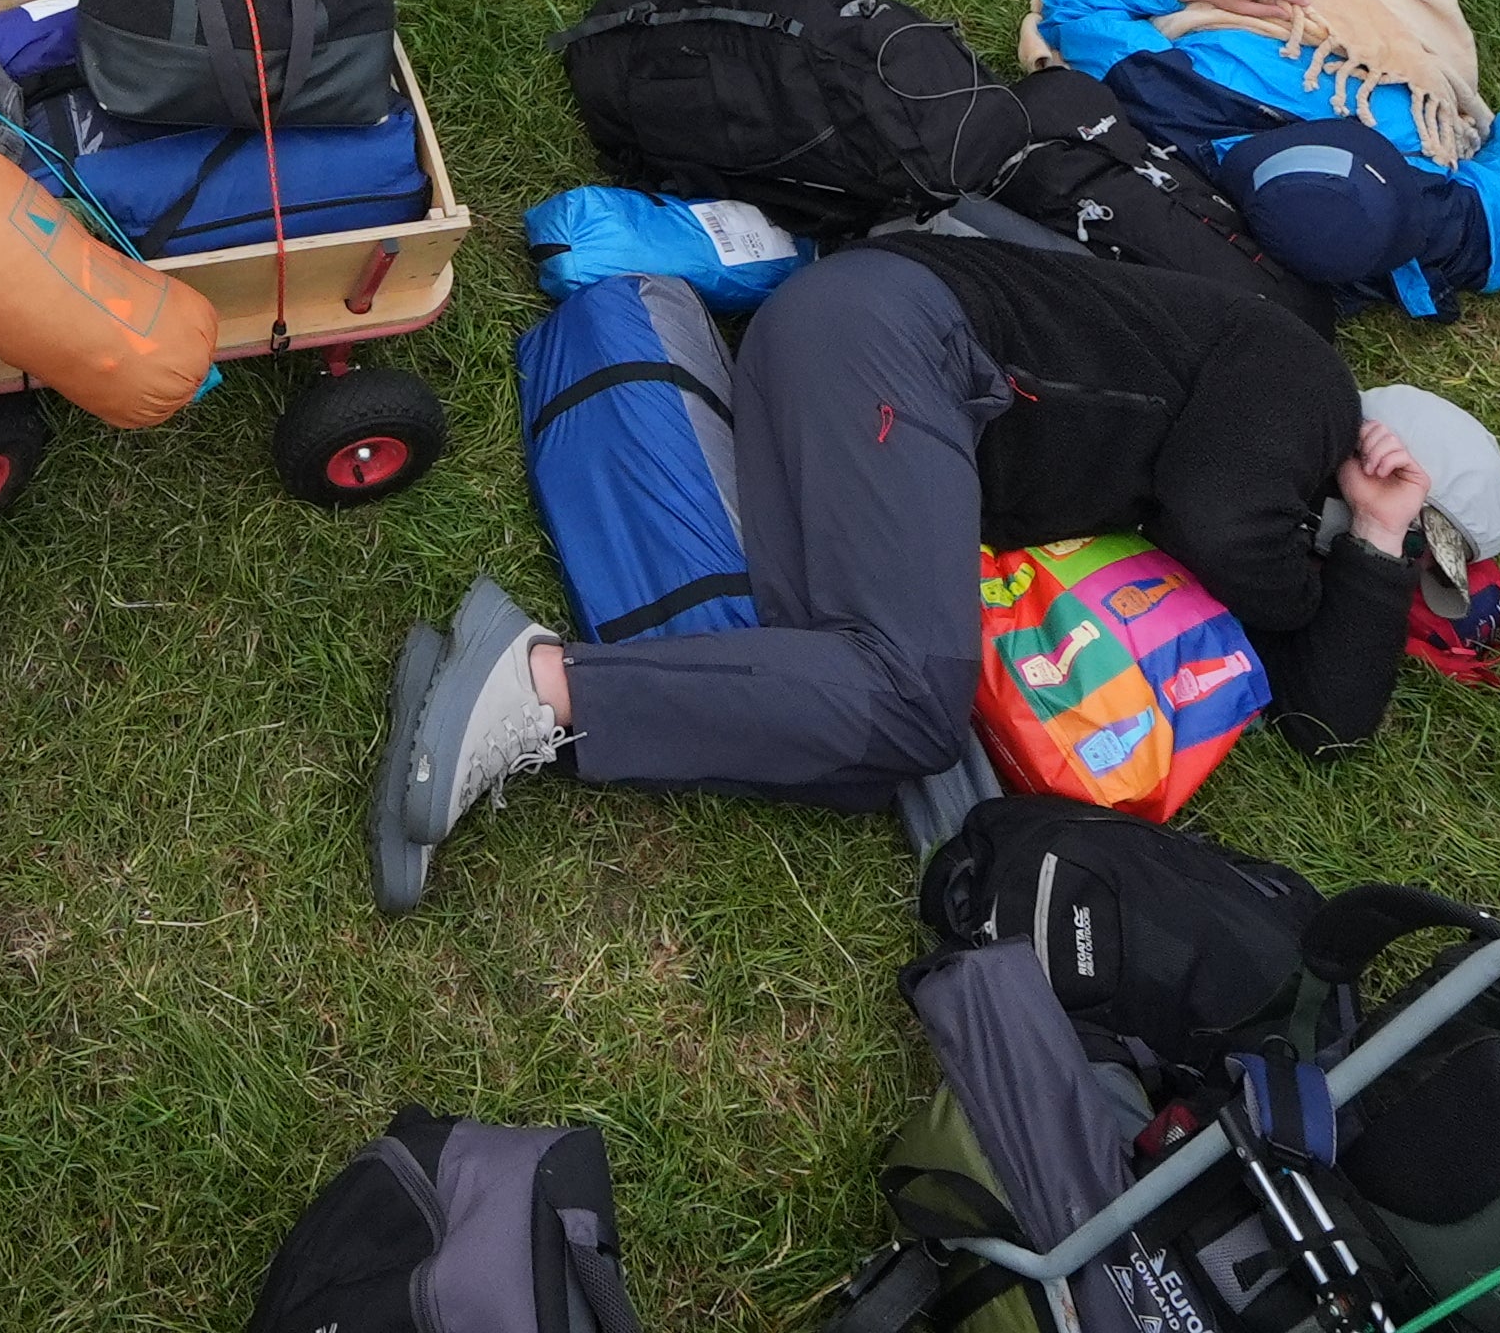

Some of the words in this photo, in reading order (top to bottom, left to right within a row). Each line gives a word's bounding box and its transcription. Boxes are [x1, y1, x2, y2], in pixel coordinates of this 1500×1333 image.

[1077, 927, 1087, 976] REGATTA
[1084, 906, 1096, 951] OUTDOORS
[1129, 1251, 1180, 1333] LOWLAND
[1159, 1269, 1214, 1333] Euro
